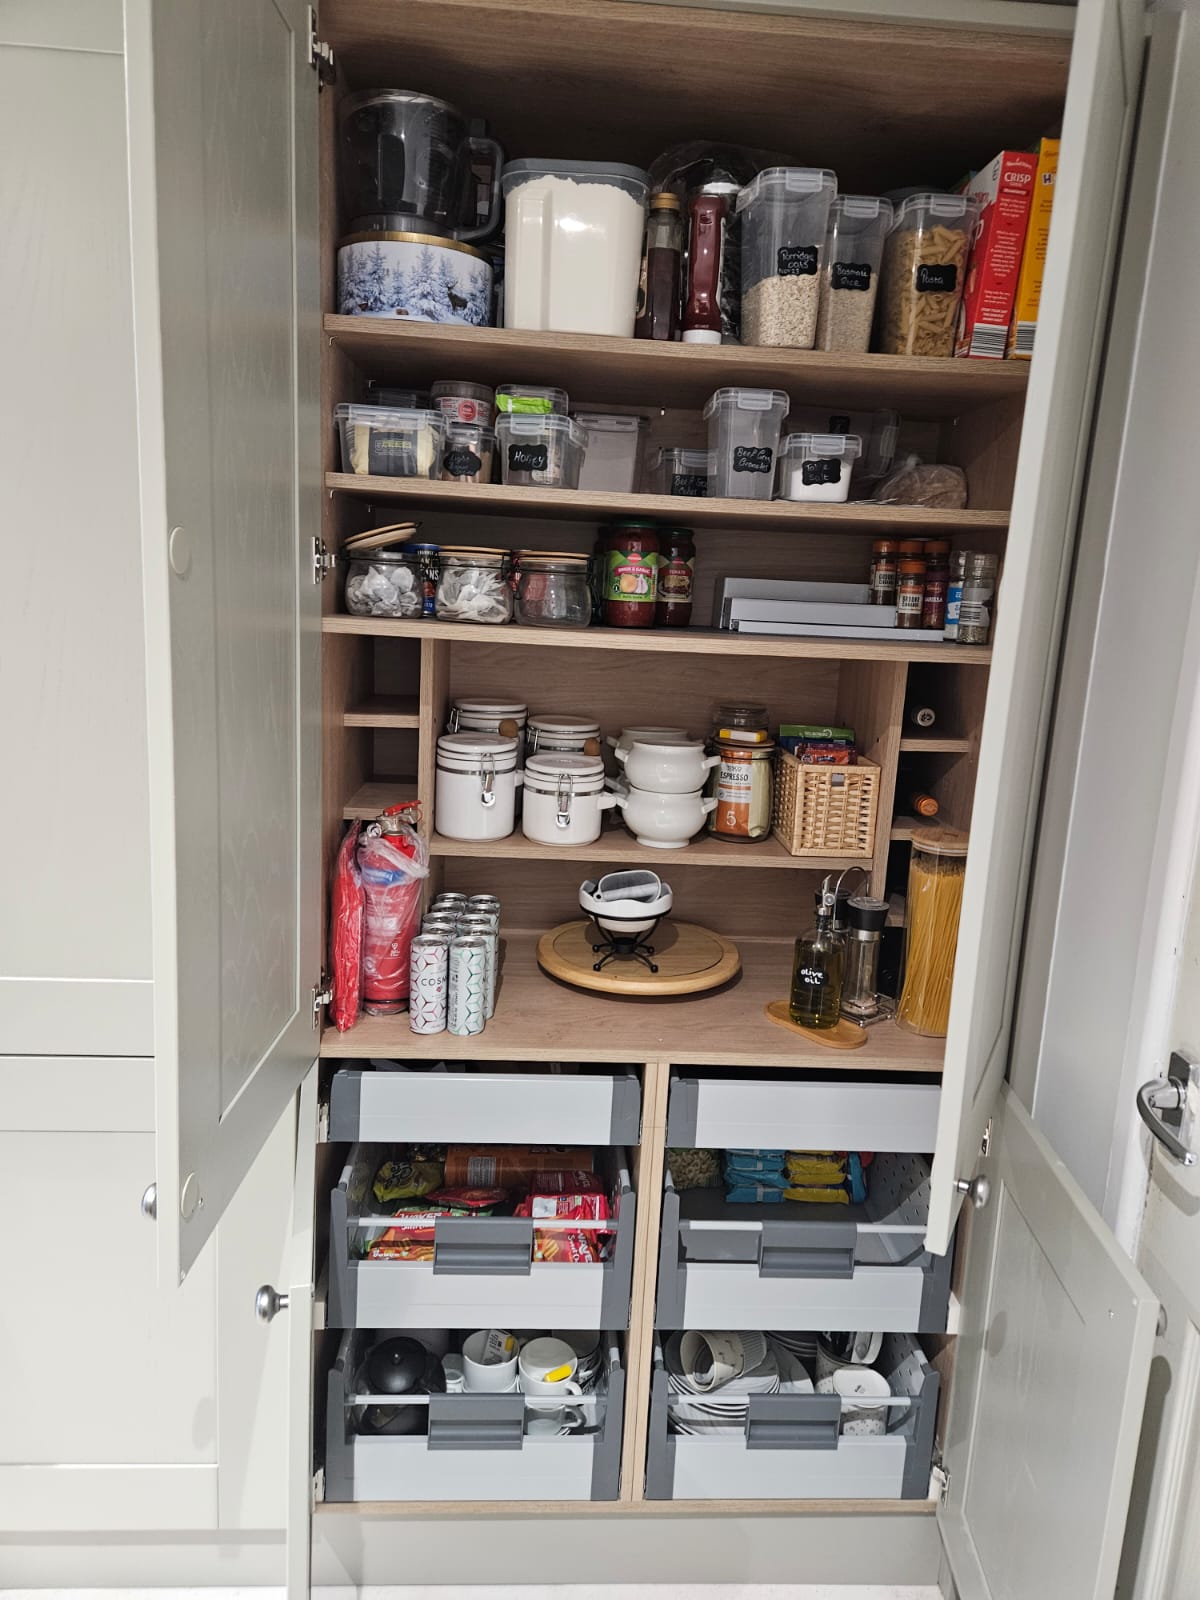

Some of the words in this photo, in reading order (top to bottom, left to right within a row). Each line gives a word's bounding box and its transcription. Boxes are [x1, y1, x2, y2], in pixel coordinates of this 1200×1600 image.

[1004, 172, 1031, 184] CRISP
[514, 451, 545, 468] Honey
[720, 771, 749, 781] ESPRESSO
[726, 810, 736, 826] 5
[801, 967, 824, 978] olive
[804, 975, 820, 984] oil
